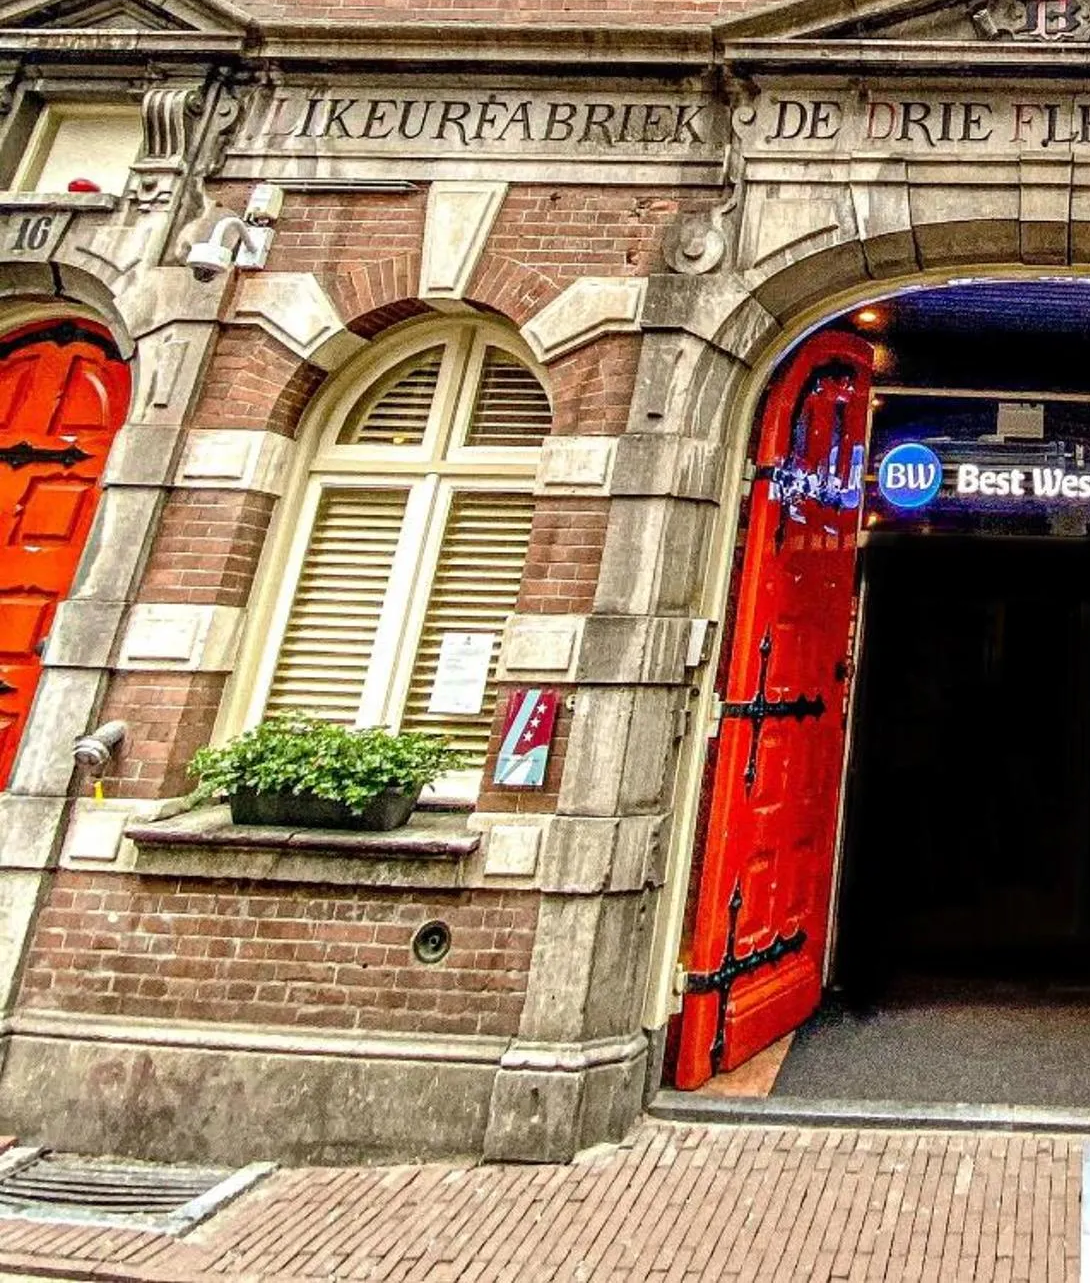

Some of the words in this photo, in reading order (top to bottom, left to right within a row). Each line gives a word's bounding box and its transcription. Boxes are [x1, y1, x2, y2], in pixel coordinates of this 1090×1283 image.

[263, 97, 706, 147] LIKEURFABRIEK
[771, 101, 842, 140] DE
[866, 101, 994, 149] DRIE
[11, 216, 52, 251] 16
[885, 462, 937, 491] BW
[957, 463, 1023, 497] Best
